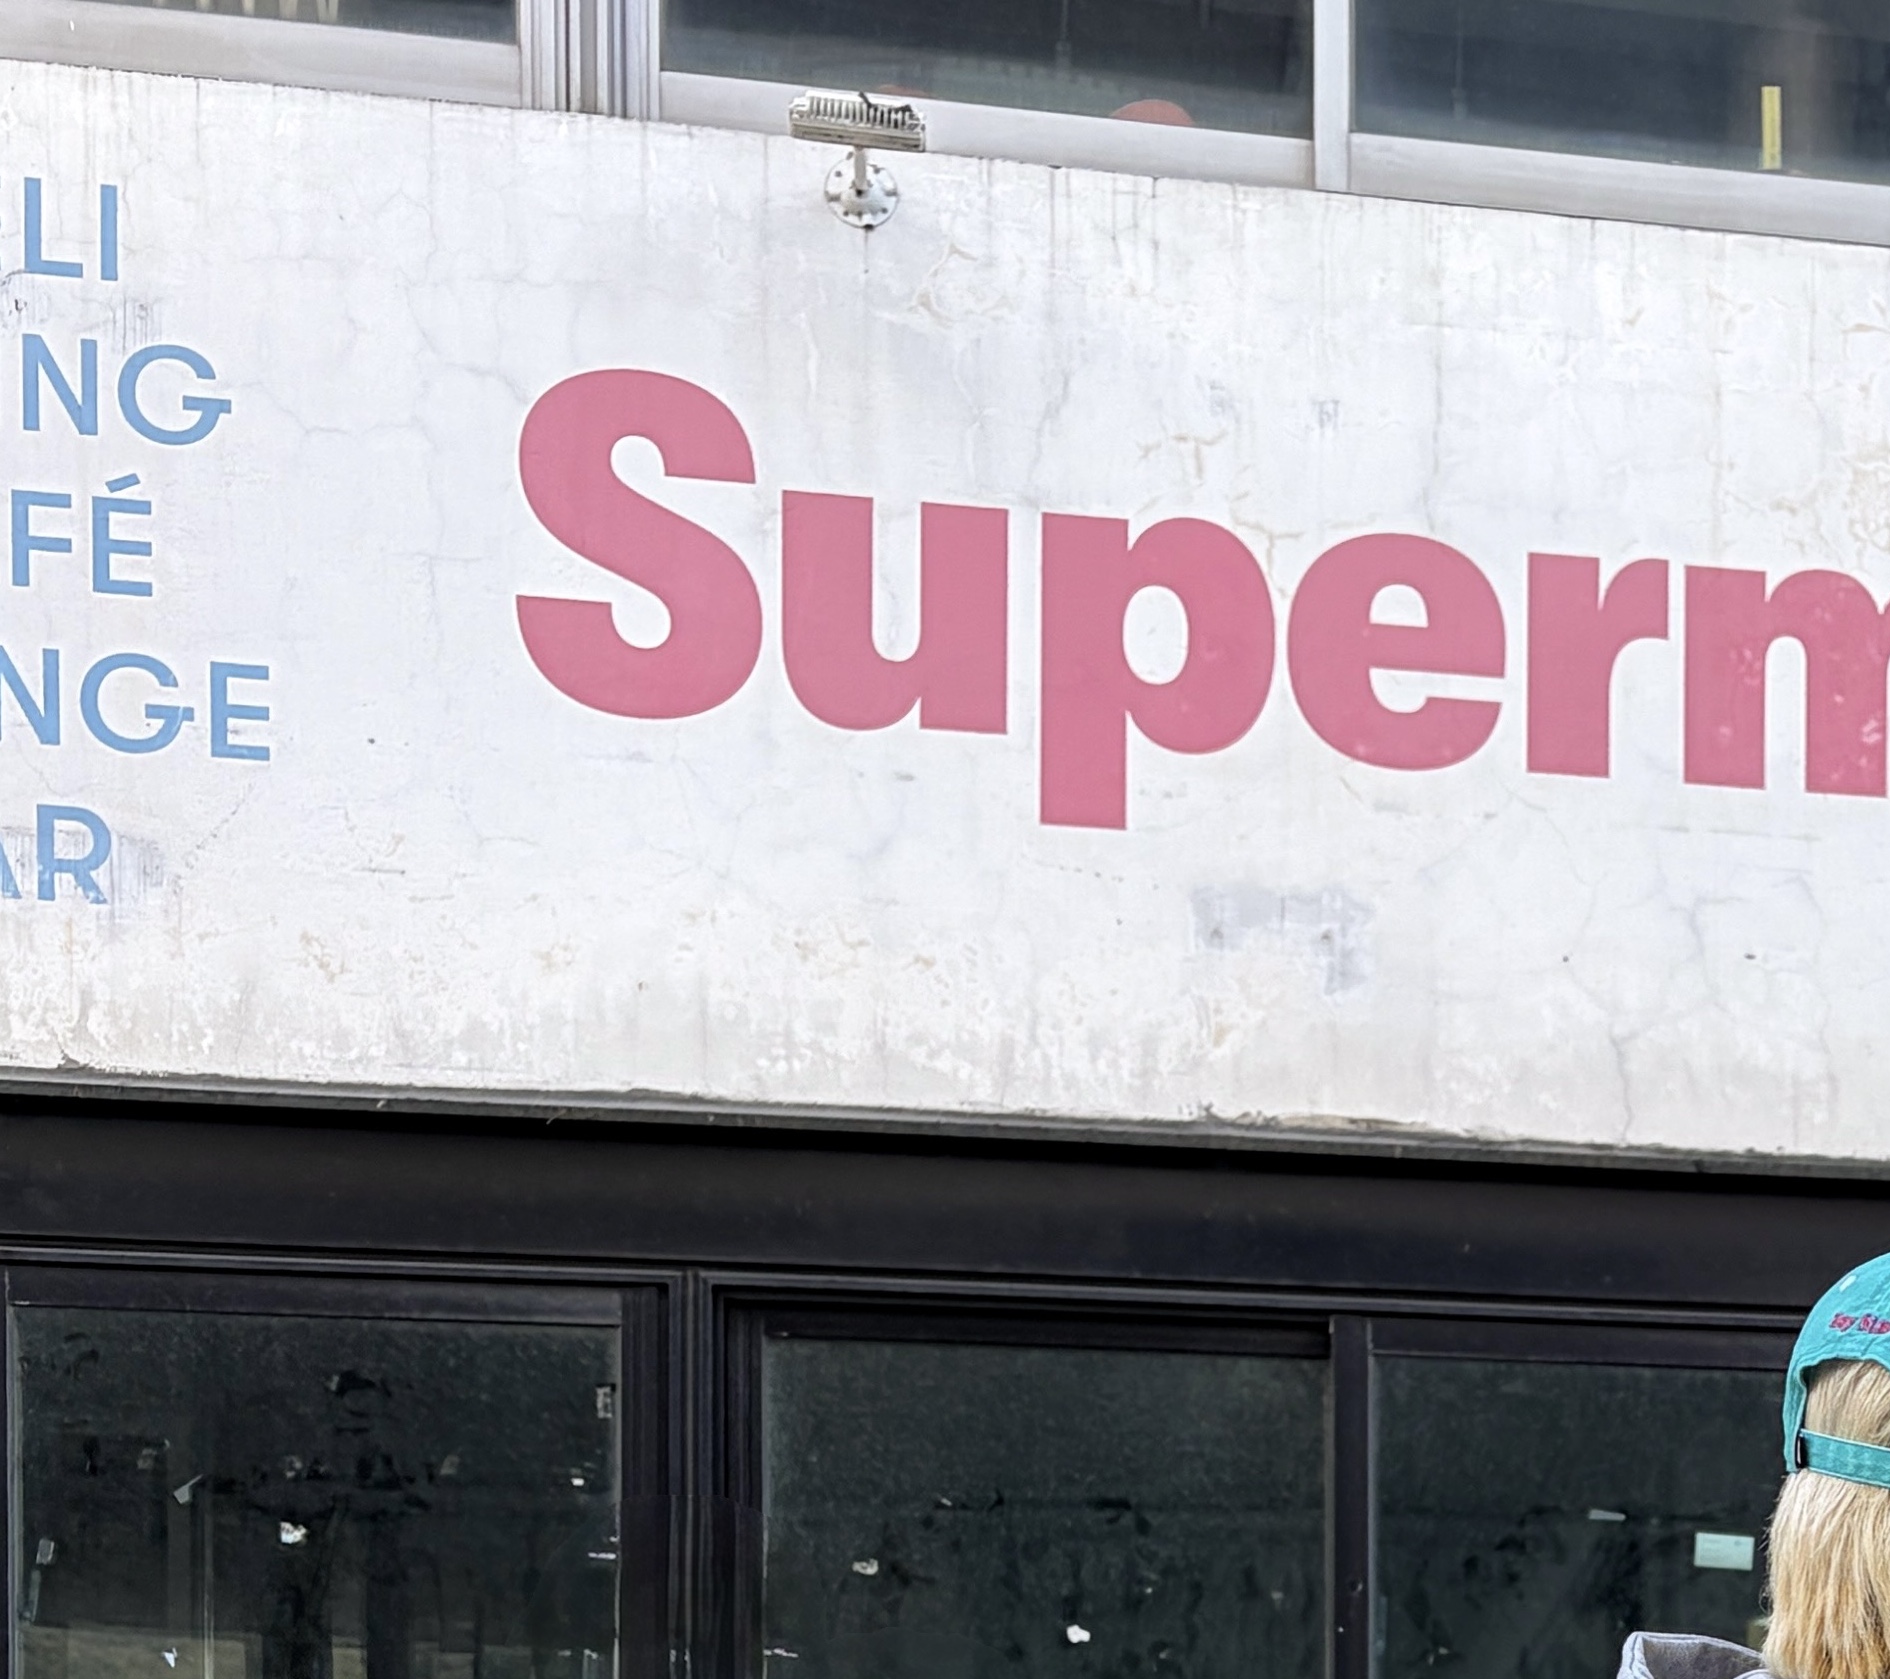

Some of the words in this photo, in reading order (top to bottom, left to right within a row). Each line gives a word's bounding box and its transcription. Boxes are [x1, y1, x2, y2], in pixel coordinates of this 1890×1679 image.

[22, 333, 232, 446] NG
[10, 473, 154, 597] FÉ
[0, 804, 112, 905] R
